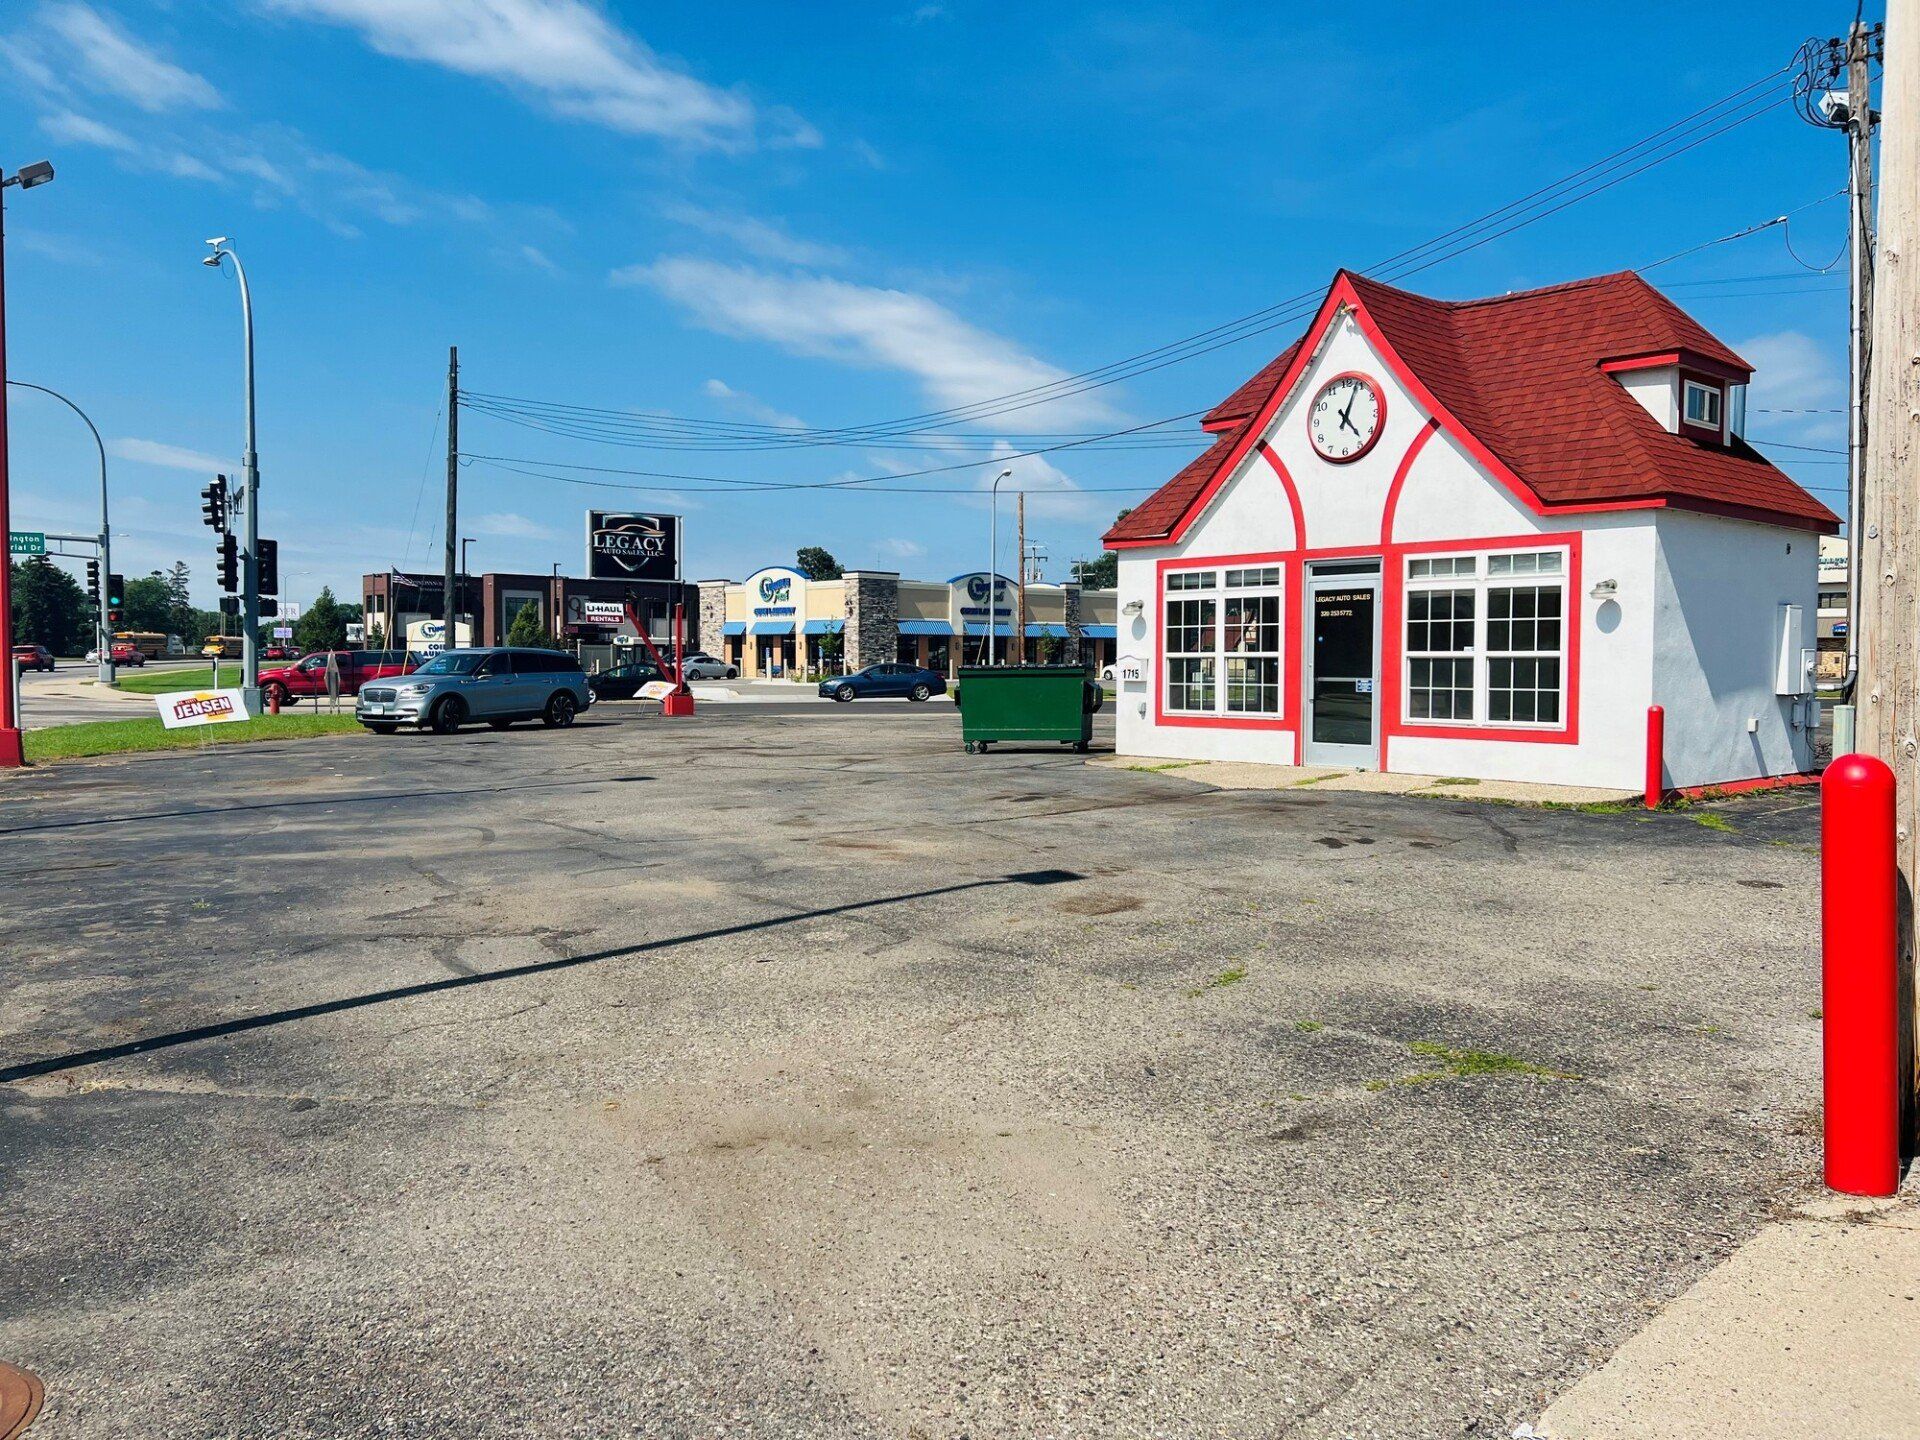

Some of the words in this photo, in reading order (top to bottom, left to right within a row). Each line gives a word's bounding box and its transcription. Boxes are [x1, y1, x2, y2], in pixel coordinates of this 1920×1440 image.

[1341, 379, 1353, 389] 12
[1328, 387, 1337, 396] 11
[1369, 393, 1375, 402] 2
[1317, 402, 1328, 412] 10
[1314, 419, 1320, 428] 9
[1368, 427, 1374, 435] 4
[1318, 434, 1325, 443] 8
[1328, 446, 1334, 454] 7
[1357, 441, 1364, 450] 5
[1342, 447, 1349, 456] 6
[10, 535, 40, 543] ington
[593, 535, 665, 551] LEGACY
[587, 605, 621, 613] U-HAUL
[1123, 669, 1139, 679] 1715
[176, 698, 231, 719] JENSEN
